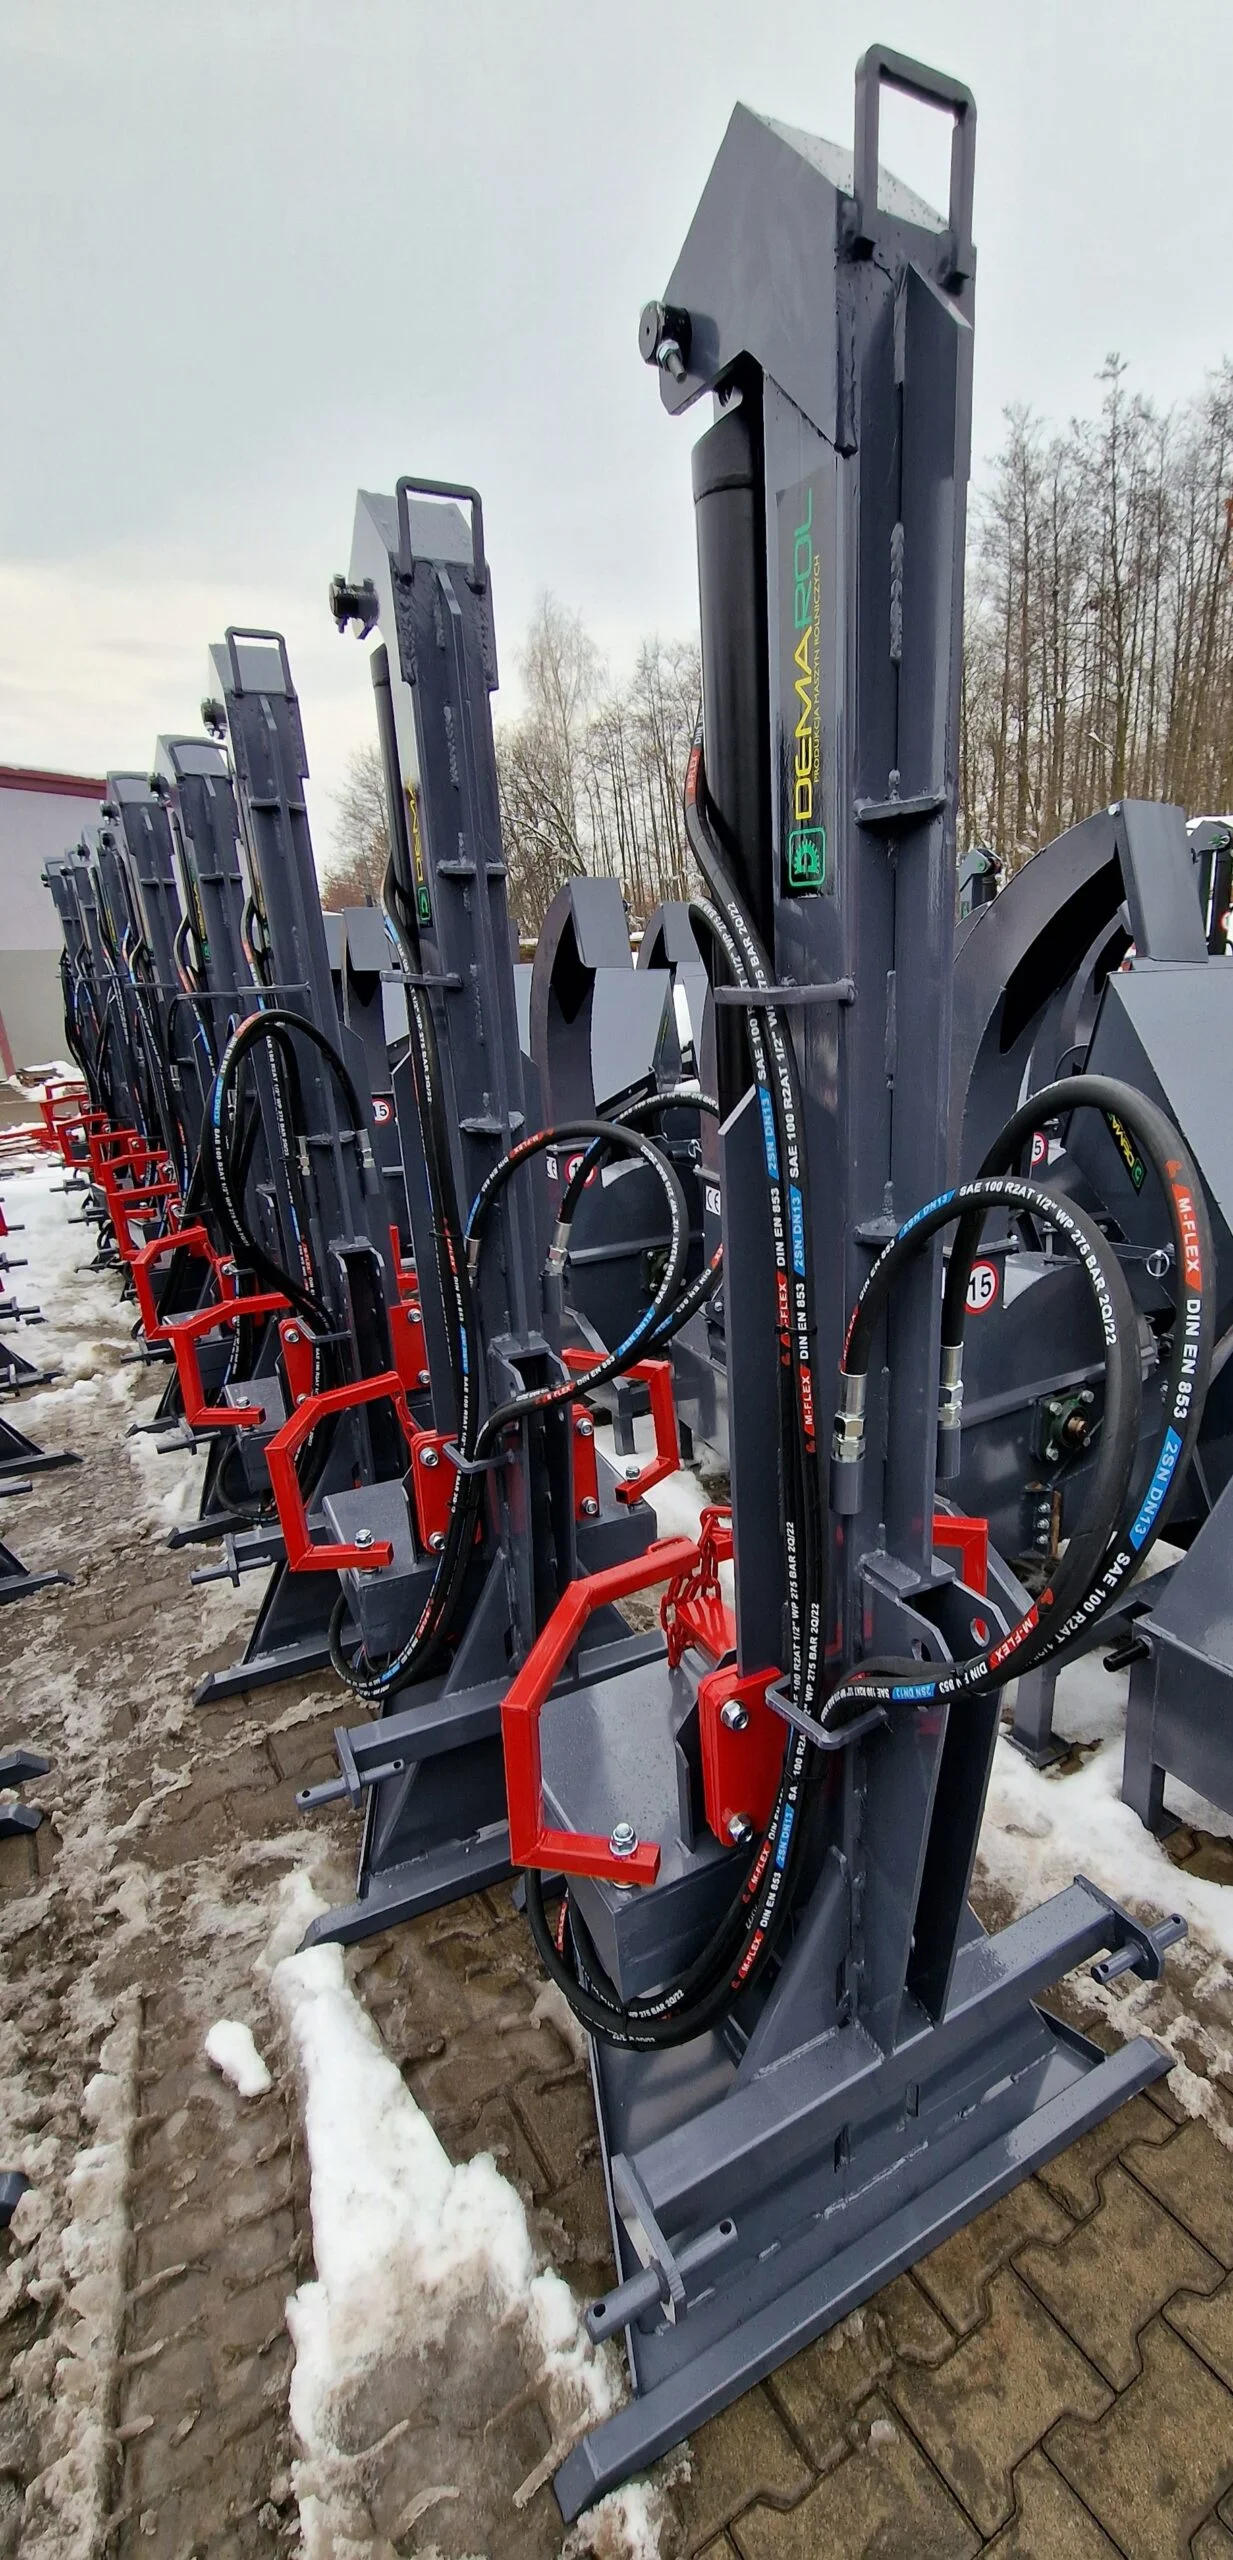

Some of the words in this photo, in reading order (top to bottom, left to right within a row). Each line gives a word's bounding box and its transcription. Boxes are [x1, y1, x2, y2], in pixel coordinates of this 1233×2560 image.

[813, 554, 821, 646] ROLNICZYCH
[794, 488, 812, 821] DEMAROL
[813, 706, 822, 783] PRODUKCJA
[727, 901, 748, 936] 2Q/22
[722, 929, 735, 948] WP
[743, 934, 760, 968] BAR
[731, 951, 745, 975] 1/2"
[749, 1017, 762, 1043] 100
[772, 1031, 786, 1062] 1/2"
[754, 1047, 767, 1081] SAE
[778, 1067, 795, 1109] R2AT
[763, 1098, 775, 1137] DN13
[785, 1114, 796, 1140] 100
[767, 1141, 777, 1171] 2SN
[788, 1145, 800, 1178] SAE
[771, 1187, 781, 1213] 853
[774, 1217, 783, 1237] EN
[793, 1196, 804, 1237] DN13
[1178, 1196, 1201, 1273] M-FLEX
[776, 1241, 786, 1267] DIN
[794, 1239, 804, 1268] 2SN
[859, 1278, 871, 1300] DIN
[869, 1259, 881, 1277] EN
[880, 1238, 896, 1259] 853
[959, 1182, 981, 1197] SAE
[985, 1181, 1003, 1193] 100
[1005, 1182, 1036, 1200] R2AT
[1035, 1193, 1057, 1211] 1/2"
[1055, 1208, 1075, 1229] WP
[1070, 1230, 1091, 1256] 275
[1085, 1255, 1106, 1292] BAR
[1098, 1293, 1118, 1346] 2Q/22
[699, 1268, 713, 1285] DIN
[969, 1272, 992, 1301] 15
[796, 1283, 806, 1308] 853
[576, 1375, 591, 1387] DIN
[591, 1367, 602, 1378] EN
[655, 1283, 669, 1304] SAE
[664, 1264, 675, 1281] 100
[670, 1237, 679, 1263] R2AT
[798, 1312, 807, 1331] EN
[1185, 1298, 1201, 1337] DIN
[799, 1336, 809, 1360] DIN
[1181, 1343, 1198, 1375] EN
[803, 1376, 813, 1425] M-FLEX
[1173, 1380, 1193, 1420] 853
[1157, 1441, 1178, 1482] 2SN
[1134, 1487, 1164, 1535] DN13
[786, 1521, 796, 1552] 2Q/22
[788, 1555, 797, 1579] BAR
[1102, 1552, 1131, 1587] SAE
[790, 1580, 798, 1601] 275
[1083, 1588, 1107, 1613] 100
[791, 1602, 800, 1620] WP
[811, 1602, 820, 1634] 2Q/22
[792, 1619, 801, 1641] 1/2"
[994, 1617, 1034, 1663] M-FLEX
[1054, 1611, 1087, 1644] R2AT
[793, 1643, 801, 1671] R2AT
[809, 1636, 819, 1661] BAR
[793, 1672, 802, 1693] 100
[807, 1662, 817, 1682] 275
[969, 1661, 989, 1681] DIN
[804, 1682, 815, 1702] WP
[938, 1679, 955, 1694] 853
[797, 1734, 807, 1756] R2A
[793, 1757, 803, 1776] 100
[788, 1785, 798, 1801] SA
[768, 1821, 778, 1841] DIN
[777, 1837, 788, 1864] 2SN
[750, 1847, 771, 1886] M-FLEX
[771, 1872, 782, 1891] 853
[766, 1891, 777, 1909] EN
[760, 1909, 772, 1928] DIN
[741, 1937, 762, 1973] M-FLEX
[650, 2003, 667, 2015] BAR
